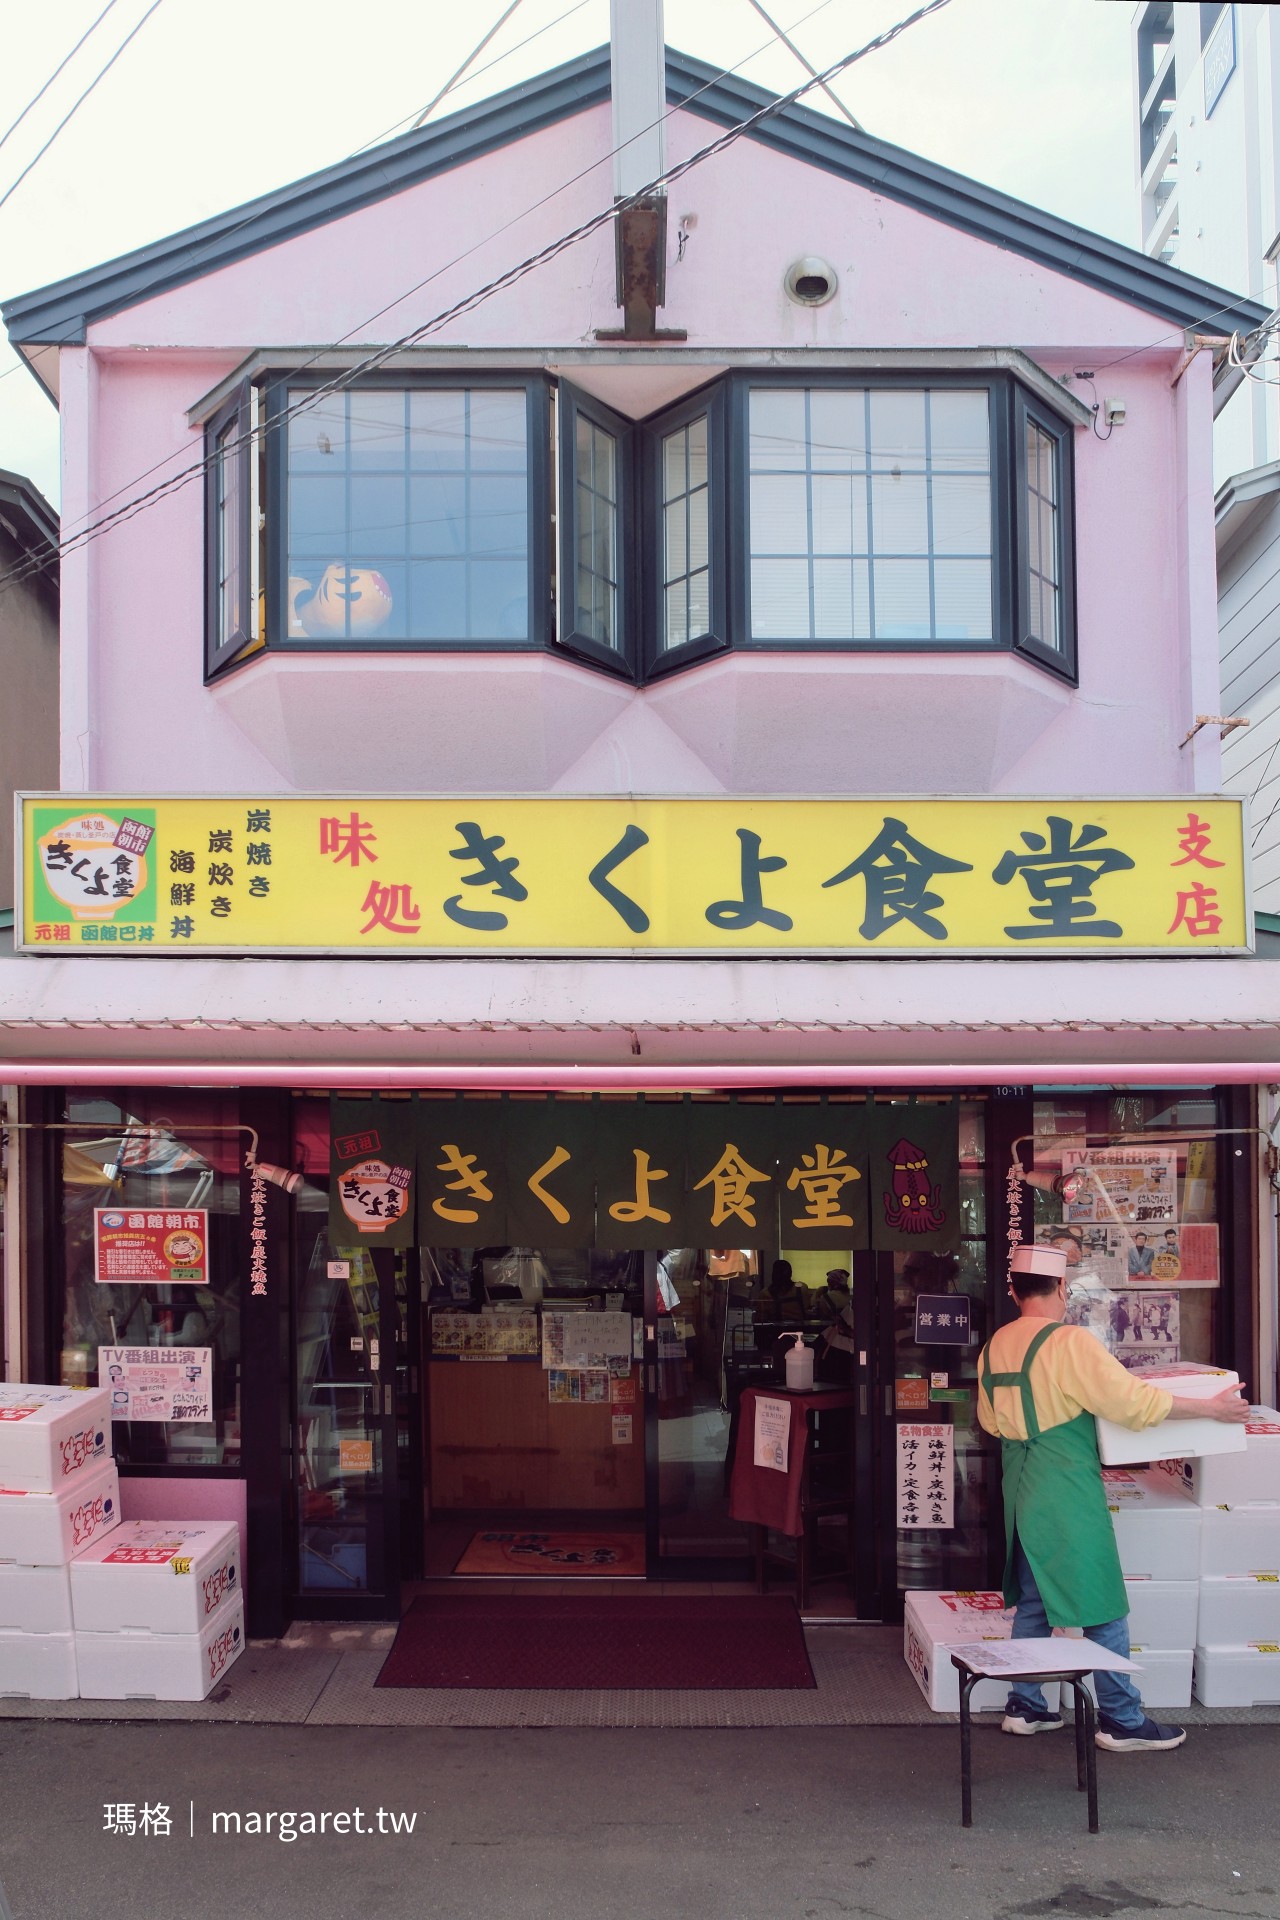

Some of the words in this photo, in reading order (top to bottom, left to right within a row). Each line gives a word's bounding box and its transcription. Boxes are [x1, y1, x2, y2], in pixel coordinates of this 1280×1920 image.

[81, 819, 105, 831] 味処
[245, 808, 272, 898] 炭焼き
[46, 840, 110, 896] きくよ
[110, 854, 135, 898] 食堂
[208, 828, 234, 918] 炭炊き
[319, 812, 422, 935] 味処
[442, 816, 1136, 941] きくよ食堂
[1167, 812, 1226, 938] 支店
[170, 849, 196, 940] 海鮮丼
[34, 924, 71, 941] 元祖
[81, 925, 155, 942] 函館巴丼
[996, 1086, 1024, 1096] 10-11
[343, 1135, 374, 1155] 元祖
[364, 1164, 381, 1173] 味処
[432, 1142, 861, 1228] きくよ食堂
[343, 1178, 384, 1217] きくよ
[383, 1189, 401, 1218] 食堂
[128, 1214, 200, 1229] 函館朝市
[919, 1312, 968, 1328] 営業中
[897, 1391, 927, 1399] 食べログ
[899, 1425, 952, 1437] 名物食堂!
[341, 1451, 370, 1460] 食べログ
